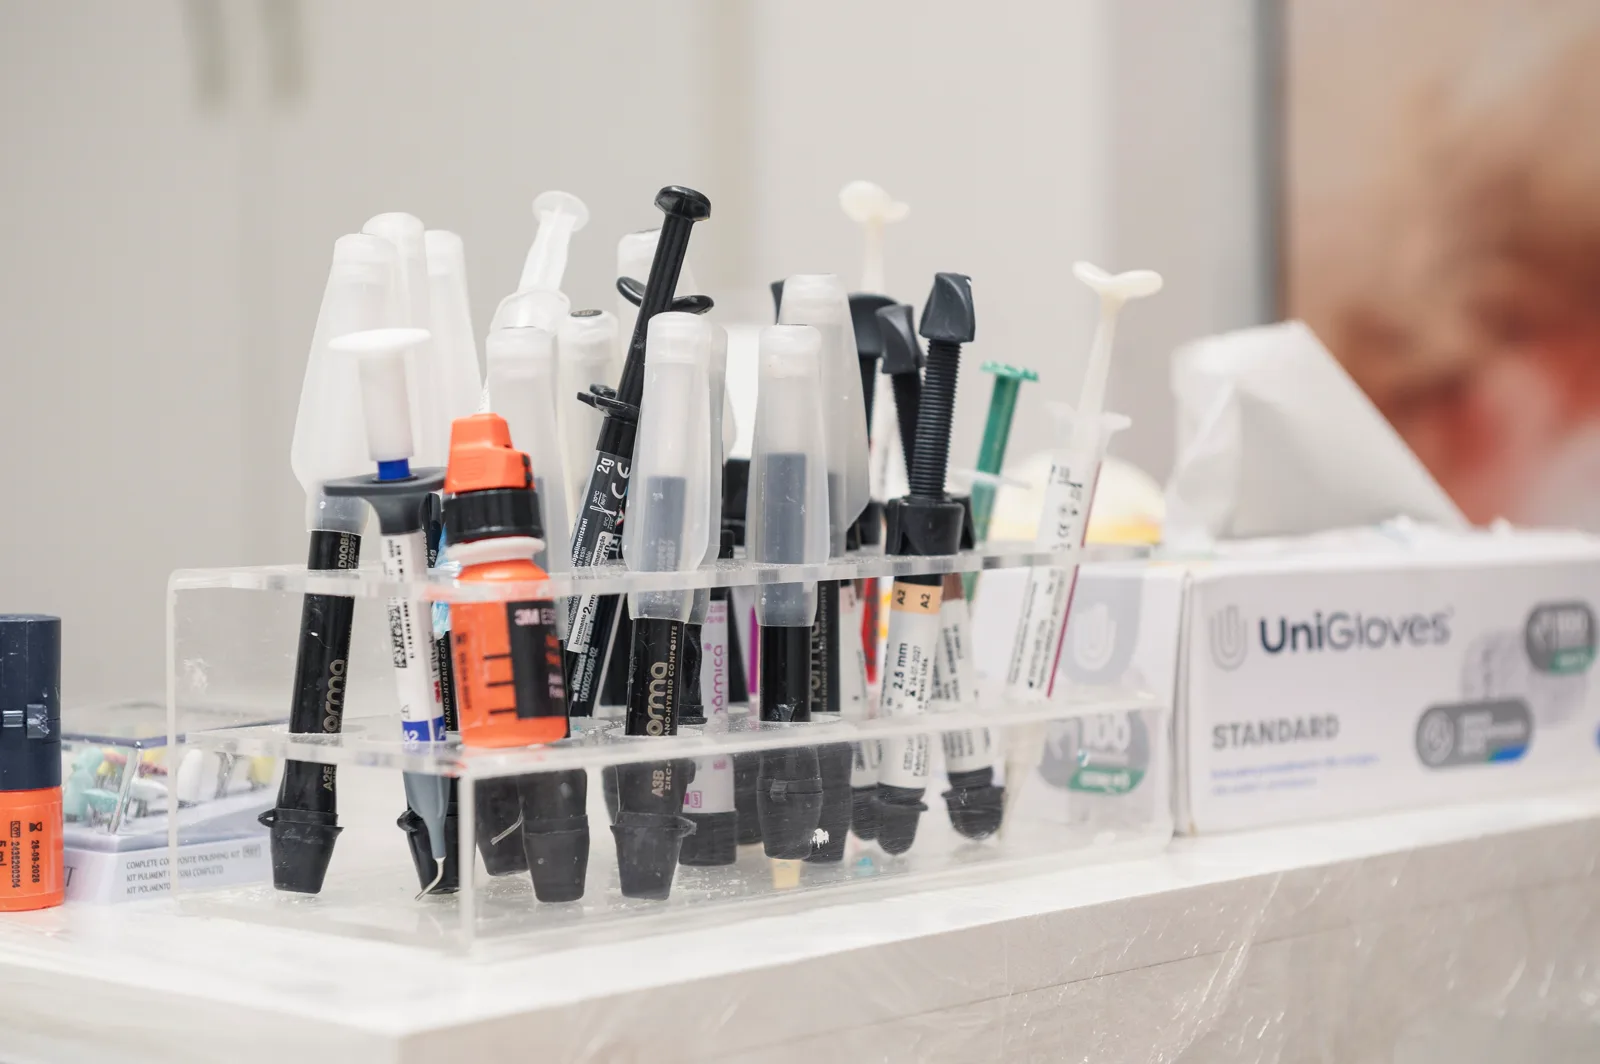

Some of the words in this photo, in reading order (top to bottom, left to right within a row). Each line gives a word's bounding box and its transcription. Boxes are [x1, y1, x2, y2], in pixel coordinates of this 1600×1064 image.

[597, 457, 615, 474] 2g
[895, 589, 905, 605] A2
[919, 593, 930, 608] A2
[514, 608, 540, 626] 3M
[1259, 611, 1452, 654] UniGloves
[896, 642, 908, 667] mm
[664, 679, 674, 736] ANO-HYBRID
[669, 625, 678, 676] COMPOSITE
[894, 671, 905, 690] 2,5
[322, 658, 346, 733] orma
[1211, 714, 1341, 750] STANDARD
[126, 858, 157, 869] COMPLETE
[159, 855, 196, 866] COPOSITE
[197, 851, 228, 862] POLISHING
[126, 873, 136, 881] KIT
[126, 886, 135, 894] KIT
[137, 883, 170, 893] POLIMENTO
